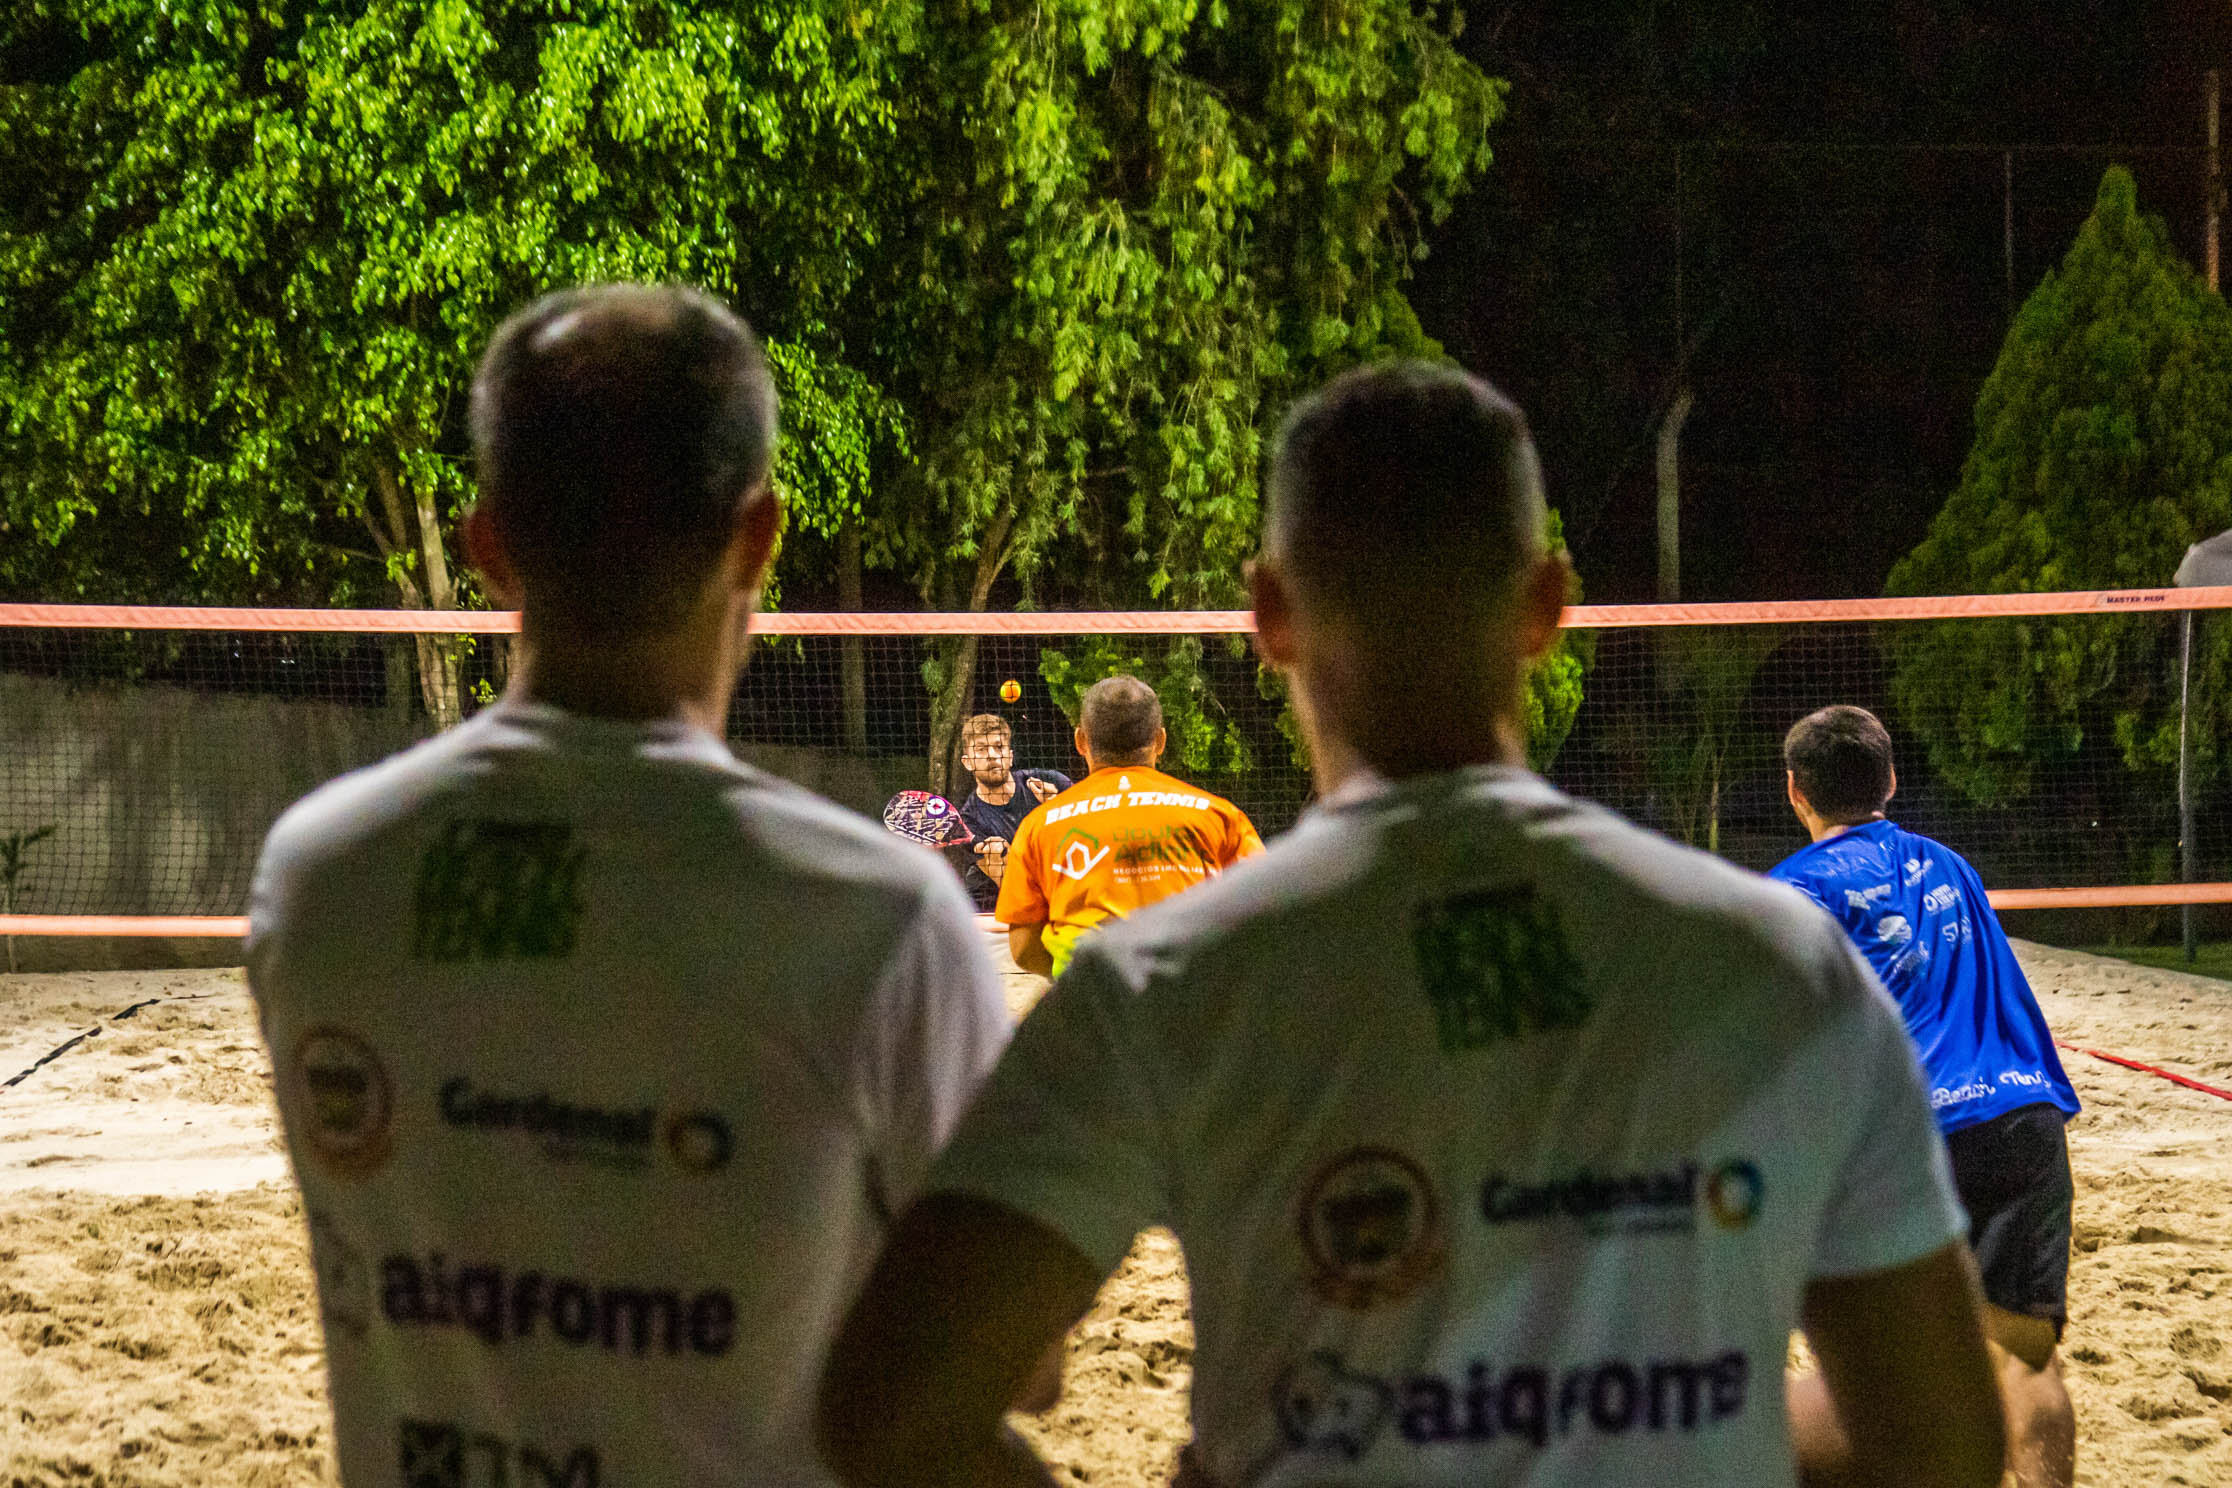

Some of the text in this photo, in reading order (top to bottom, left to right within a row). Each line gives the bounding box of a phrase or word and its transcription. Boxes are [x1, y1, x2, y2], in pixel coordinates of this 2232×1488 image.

[2107, 595, 2141, 603] MASTER
[1044, 791, 1211, 826] BEACH TENNIS
